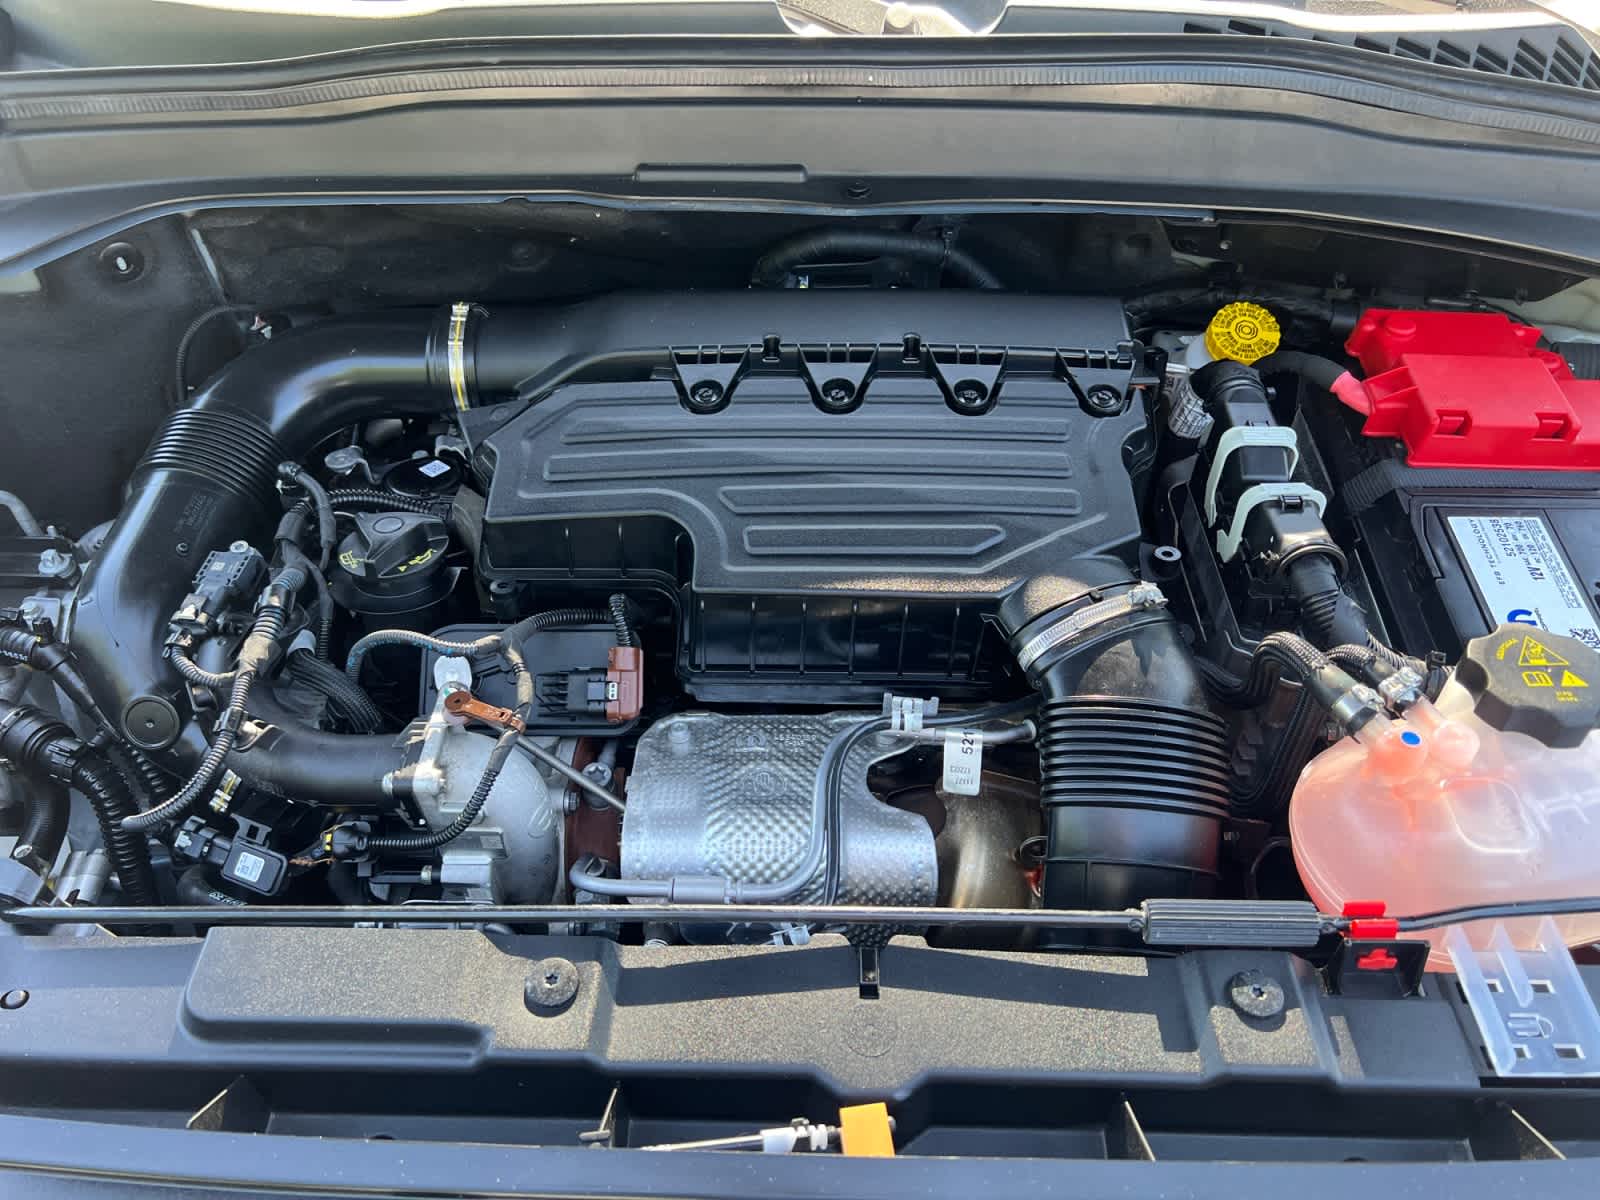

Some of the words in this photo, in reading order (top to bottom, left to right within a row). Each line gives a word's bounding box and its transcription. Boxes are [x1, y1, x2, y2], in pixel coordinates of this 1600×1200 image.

[1468, 519, 1497, 567] TECHNOLOGY
[1527, 566, 1545, 580] 12V
[962, 731, 975, 755] 521
